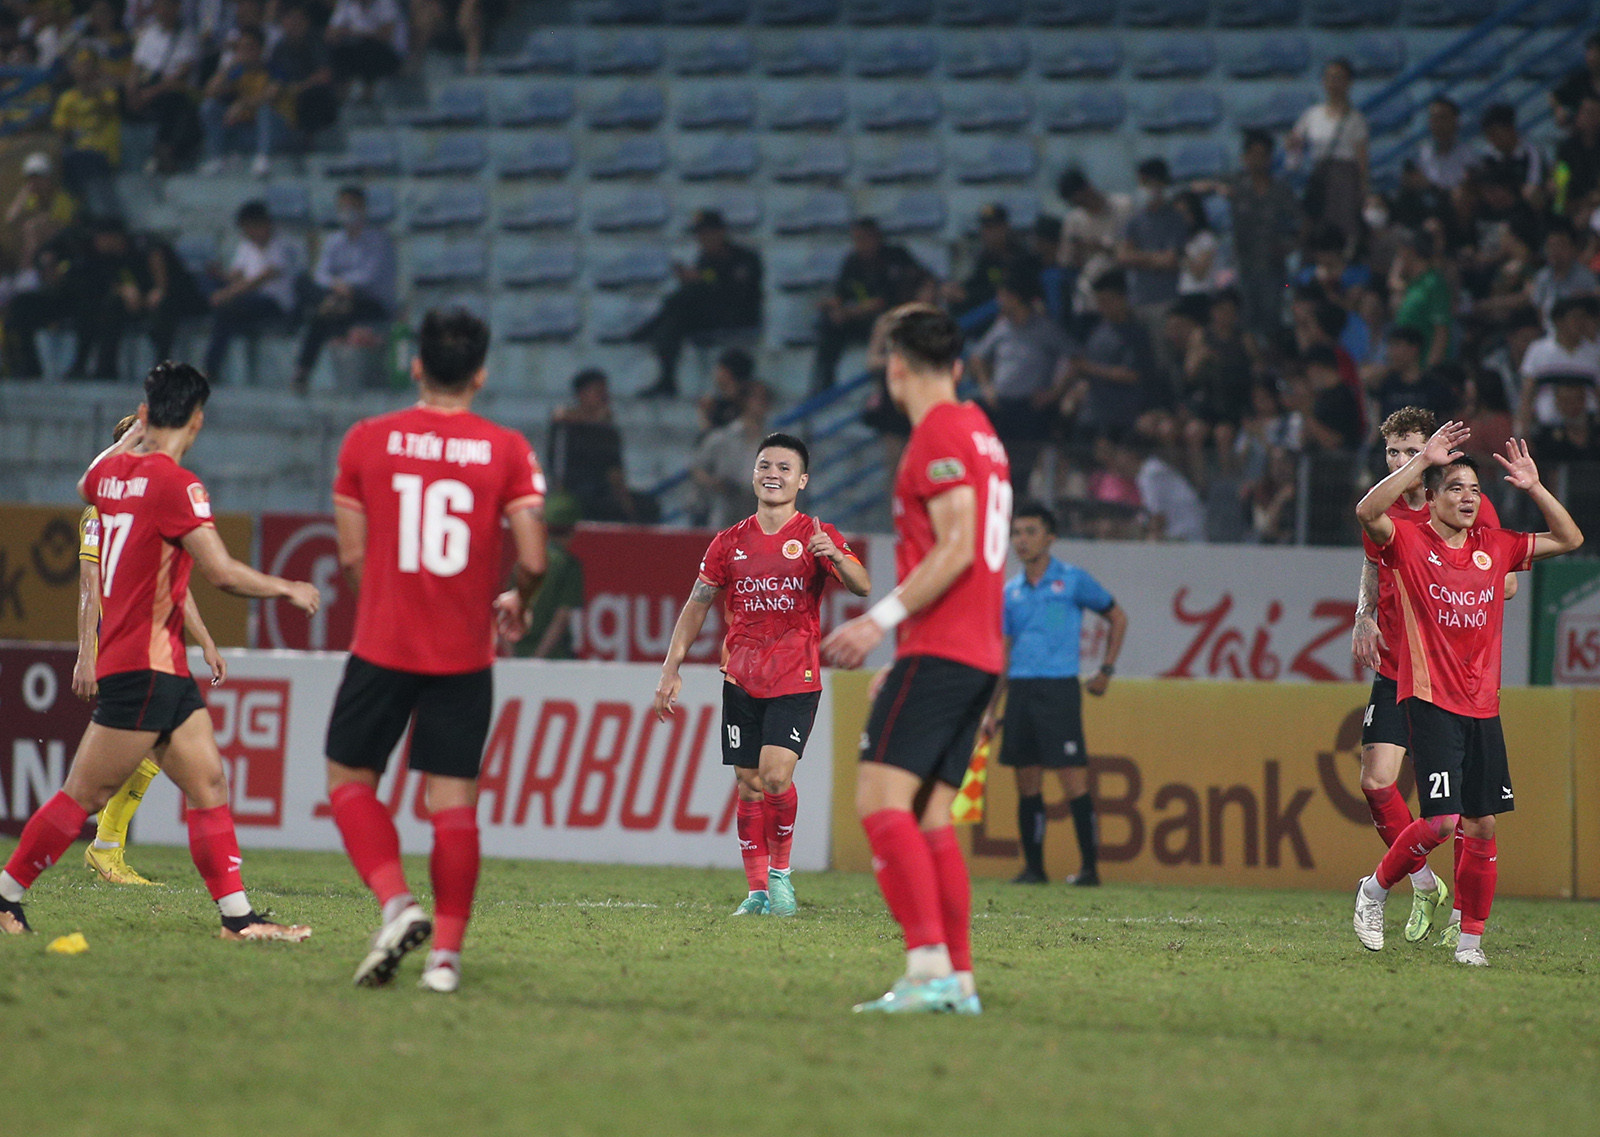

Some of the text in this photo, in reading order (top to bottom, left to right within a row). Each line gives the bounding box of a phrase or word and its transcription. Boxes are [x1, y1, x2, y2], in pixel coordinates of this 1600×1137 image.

[391, 472, 475, 578] 16
[735, 576, 804, 594] CÔNG AN
[1429, 583, 1494, 606] CÔNG AN
[744, 594, 794, 614] HÀ NỘI
[1438, 608, 1488, 630] HÀ NỘI
[727, 724, 741, 749] 19
[1428, 771, 1451, 799] 21
